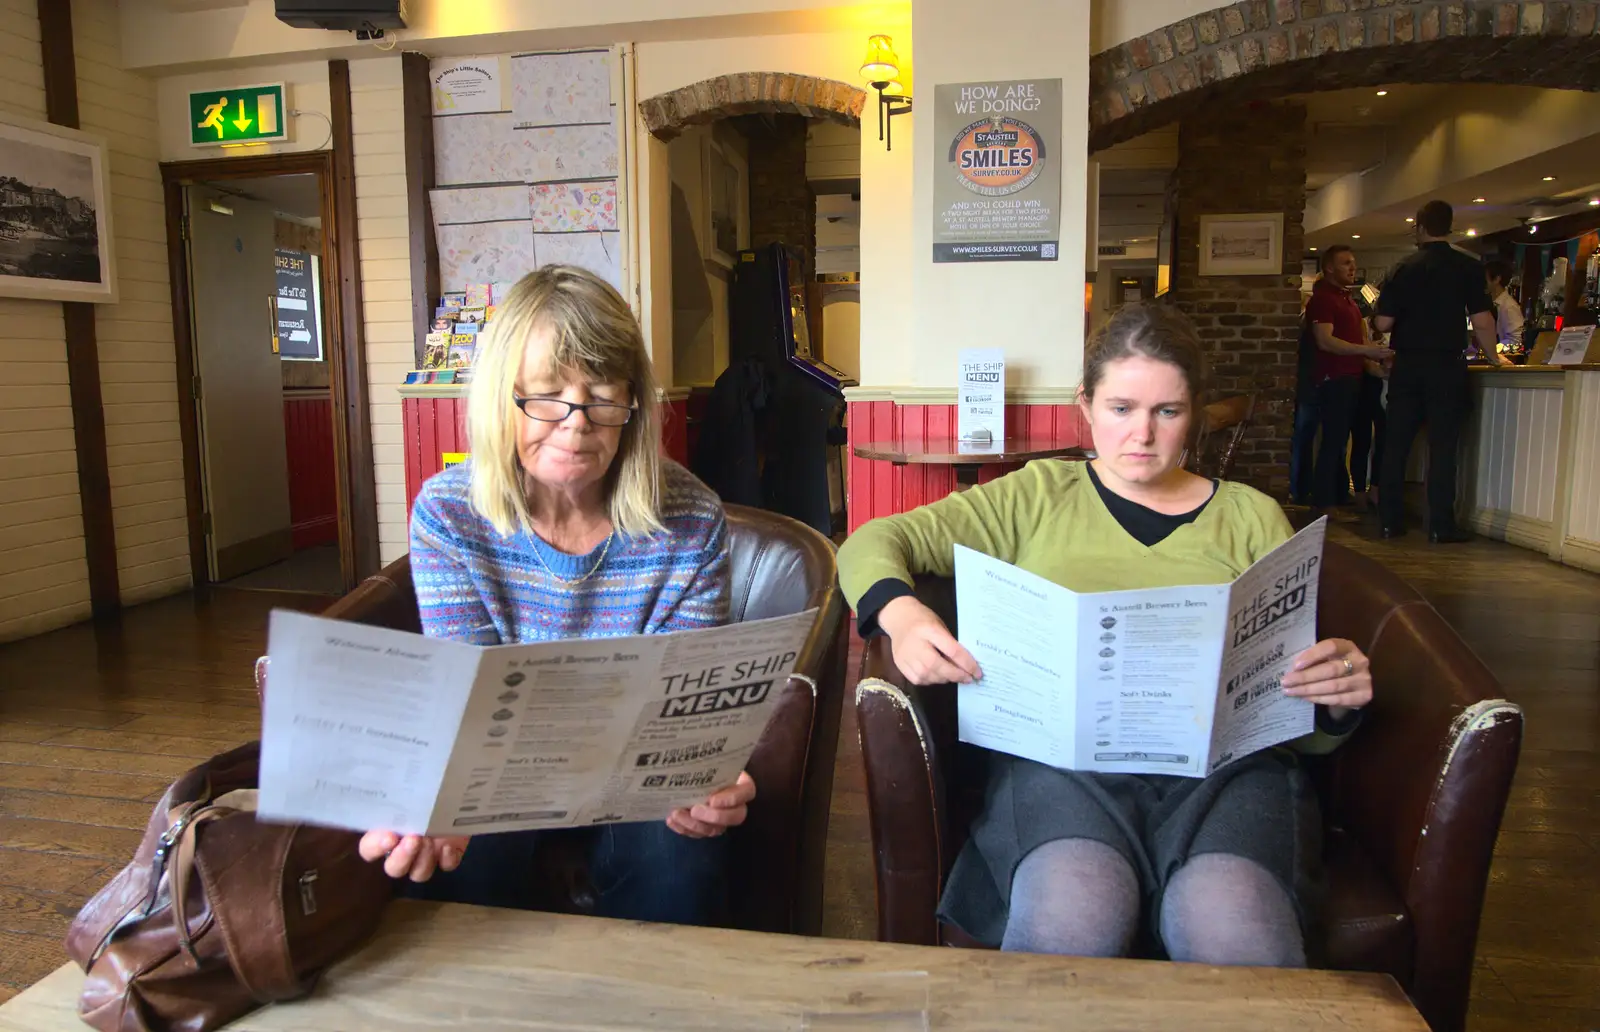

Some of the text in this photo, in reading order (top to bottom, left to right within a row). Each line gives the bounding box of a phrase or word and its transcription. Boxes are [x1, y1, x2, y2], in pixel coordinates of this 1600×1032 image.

[443, 67, 458, 76] Ship's
[961, 84, 1034, 100] HOW ARE
[955, 98, 1041, 114] WE DOING?
[986, 132, 1016, 141] AUSTELL
[961, 148, 1032, 168] SMILES
[1010, 172, 1039, 192] ONLINE
[992, 200, 1021, 208] COULD
[952, 246, 1038, 254] WWW.SMILES-SURVEY.CO.UK
[963, 362, 1003, 372] THE SHIP
[967, 373, 999, 382] MENU
[1231, 556, 1318, 629] THE SHIP
[1234, 584, 1306, 648] MENU
[661, 651, 796, 695] THE SHIP
[661, 680, 773, 718] MENU
[662, 747, 723, 764] FACEBOOK
[669, 776, 714, 786] TWITTER
